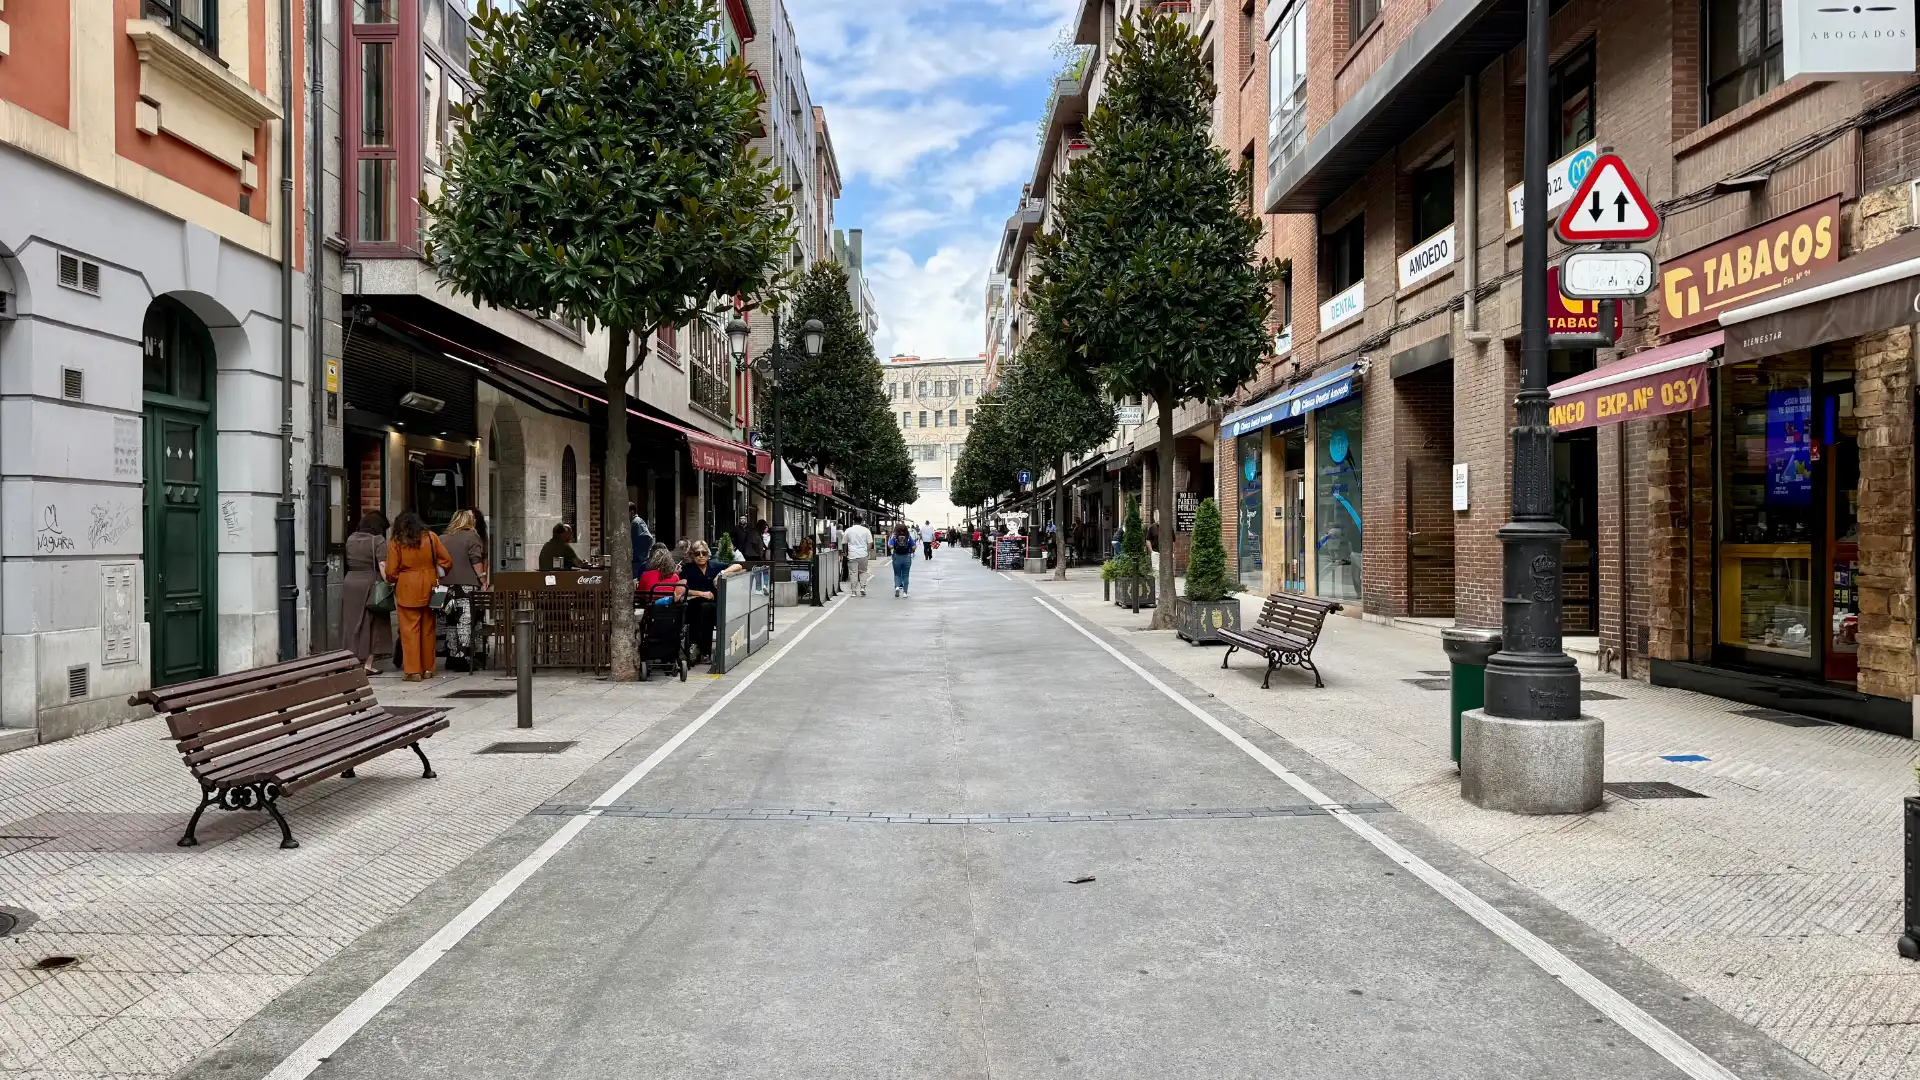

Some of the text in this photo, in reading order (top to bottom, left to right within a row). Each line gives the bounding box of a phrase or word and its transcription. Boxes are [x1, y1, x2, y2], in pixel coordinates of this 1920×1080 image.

[1811, 30, 1906, 40] ABOGADOS
[1409, 239, 1448, 277] AMOEDO
[1703, 215, 1832, 296] TABACOS
[1331, 294, 1357, 320] DENTAL
[1548, 317, 1618, 328] TABACS
[1743, 331, 1782, 348] BIENESTAR
[1315, 389, 1331, 404] Dental
[1548, 400, 1585, 426] ANCO
[1661, 377, 1698, 406] 031
